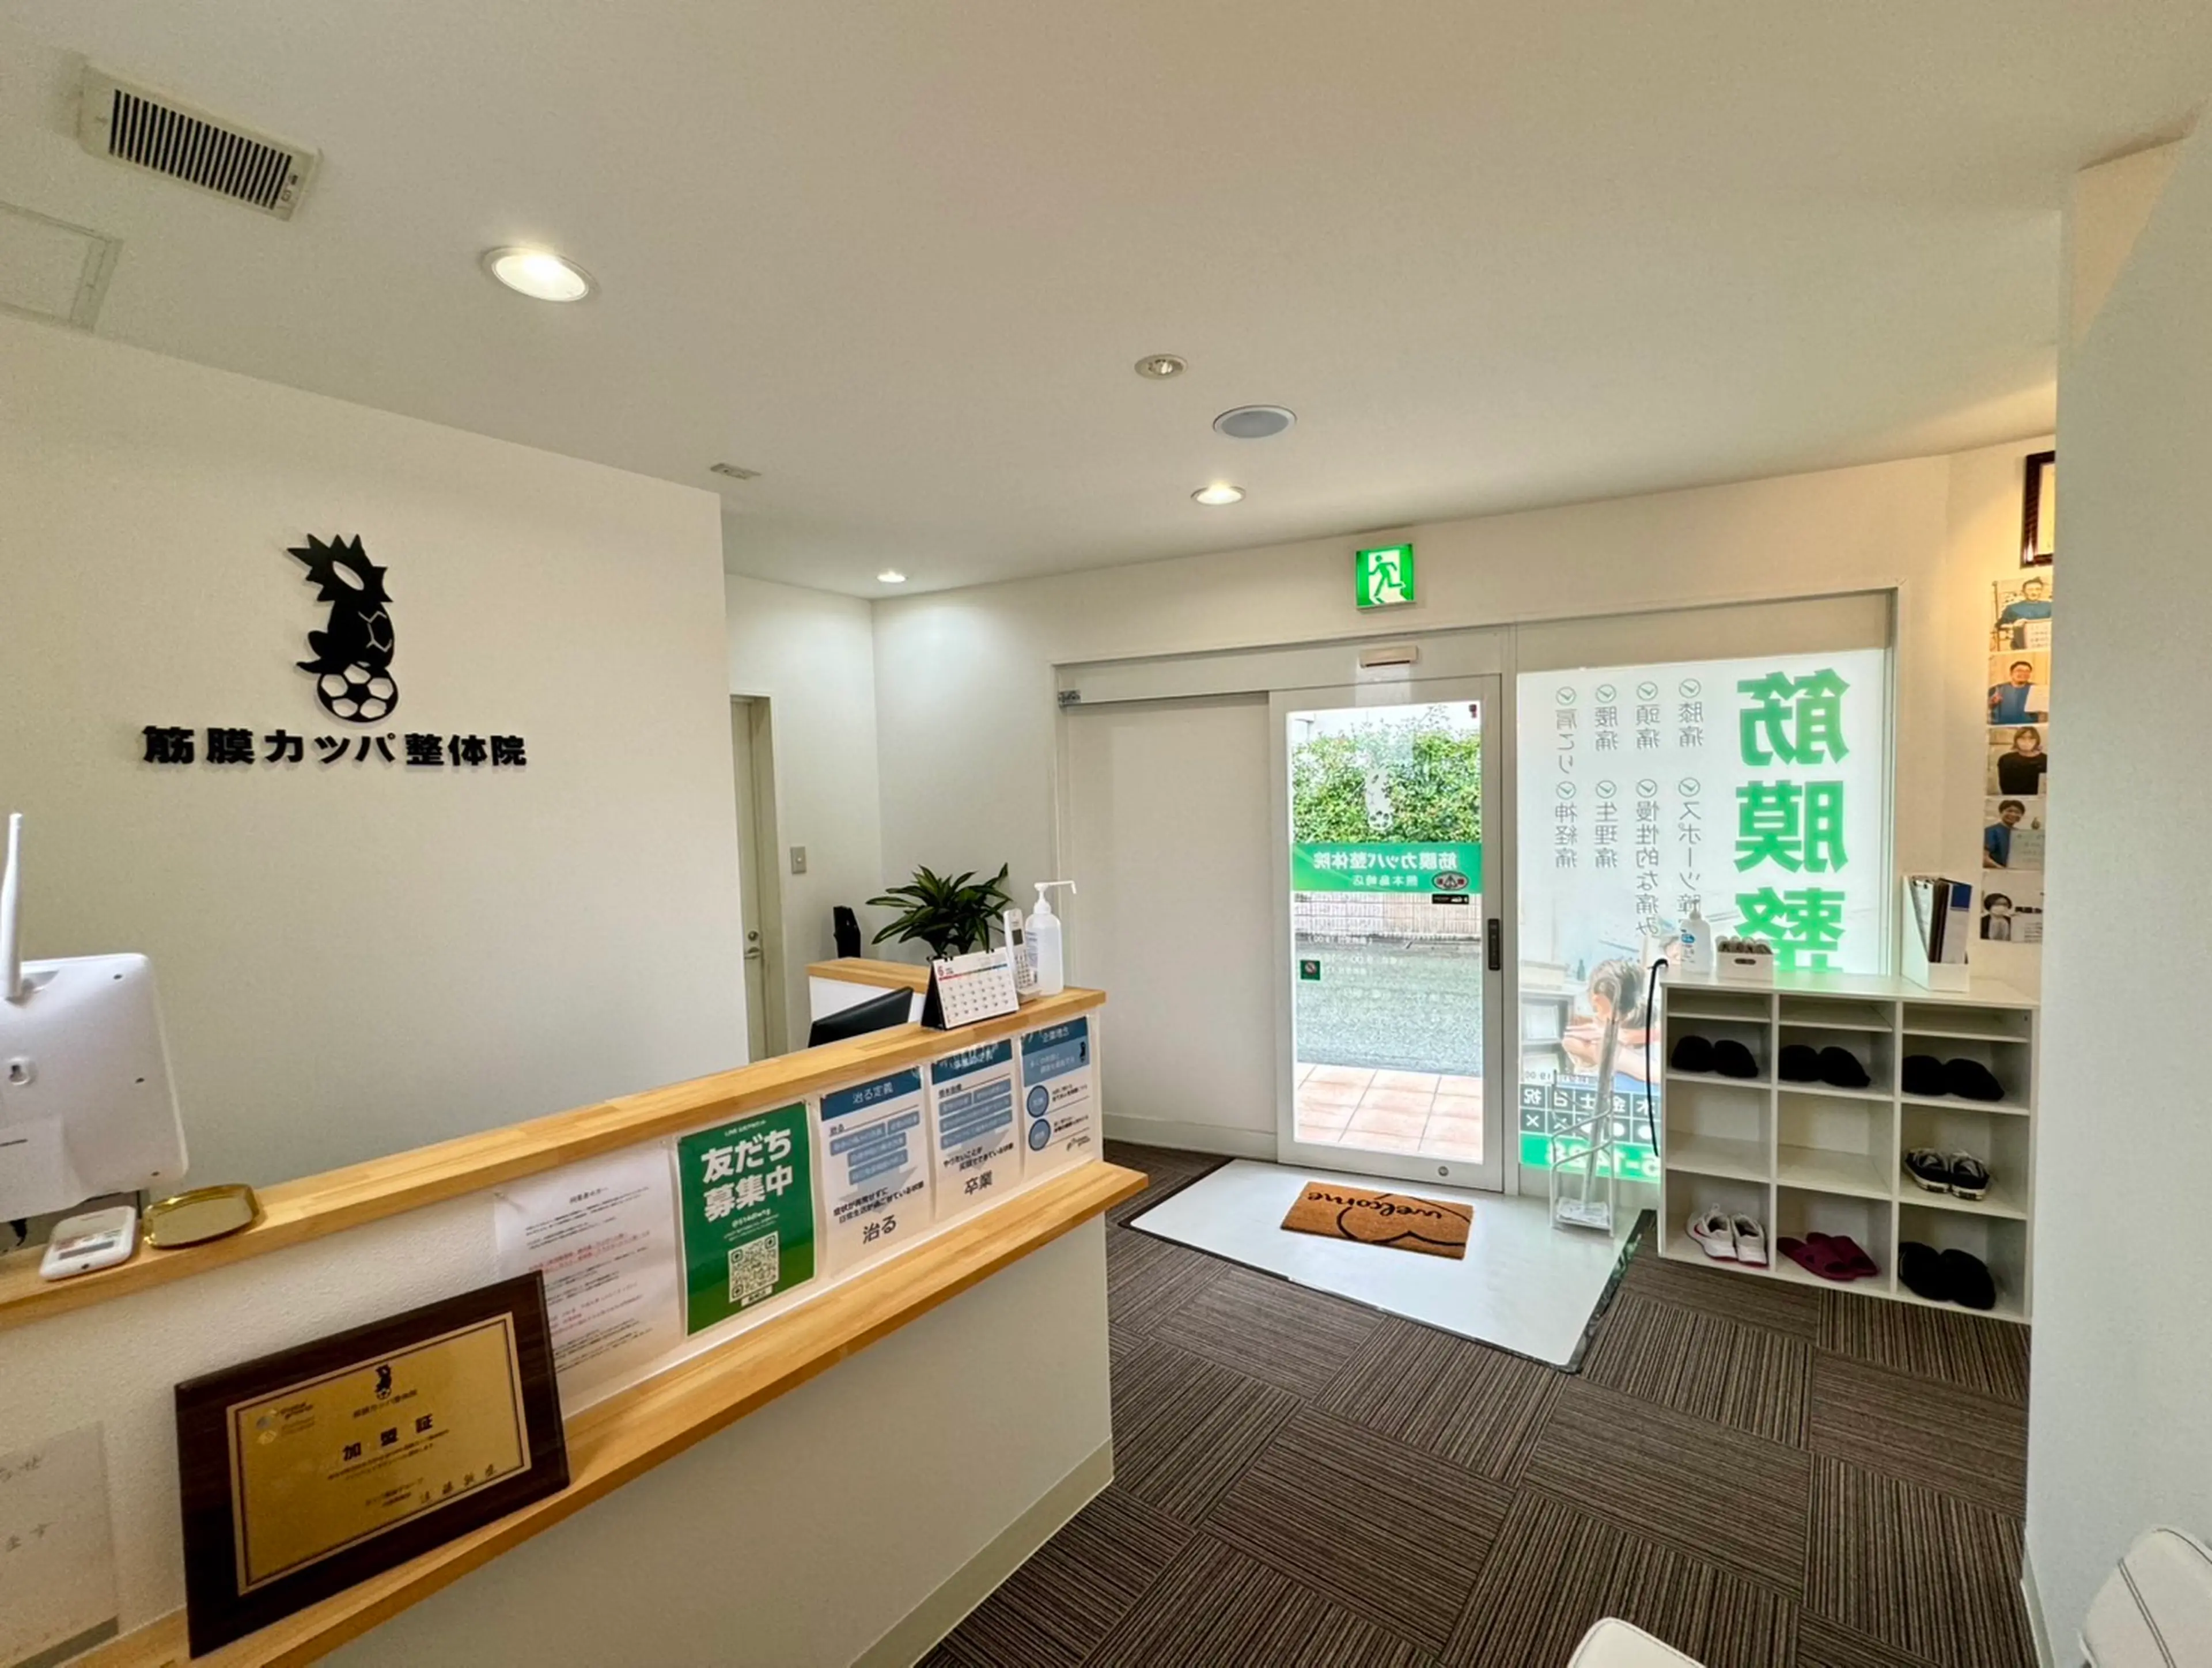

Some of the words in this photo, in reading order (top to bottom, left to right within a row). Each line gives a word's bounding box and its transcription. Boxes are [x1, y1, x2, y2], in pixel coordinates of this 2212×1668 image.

[700, 1128, 792, 1184] 友だち
[703, 1164, 794, 1223] 募集中
[964, 1169, 992, 1195] 卒業
[862, 1214, 897, 1245] 治る
